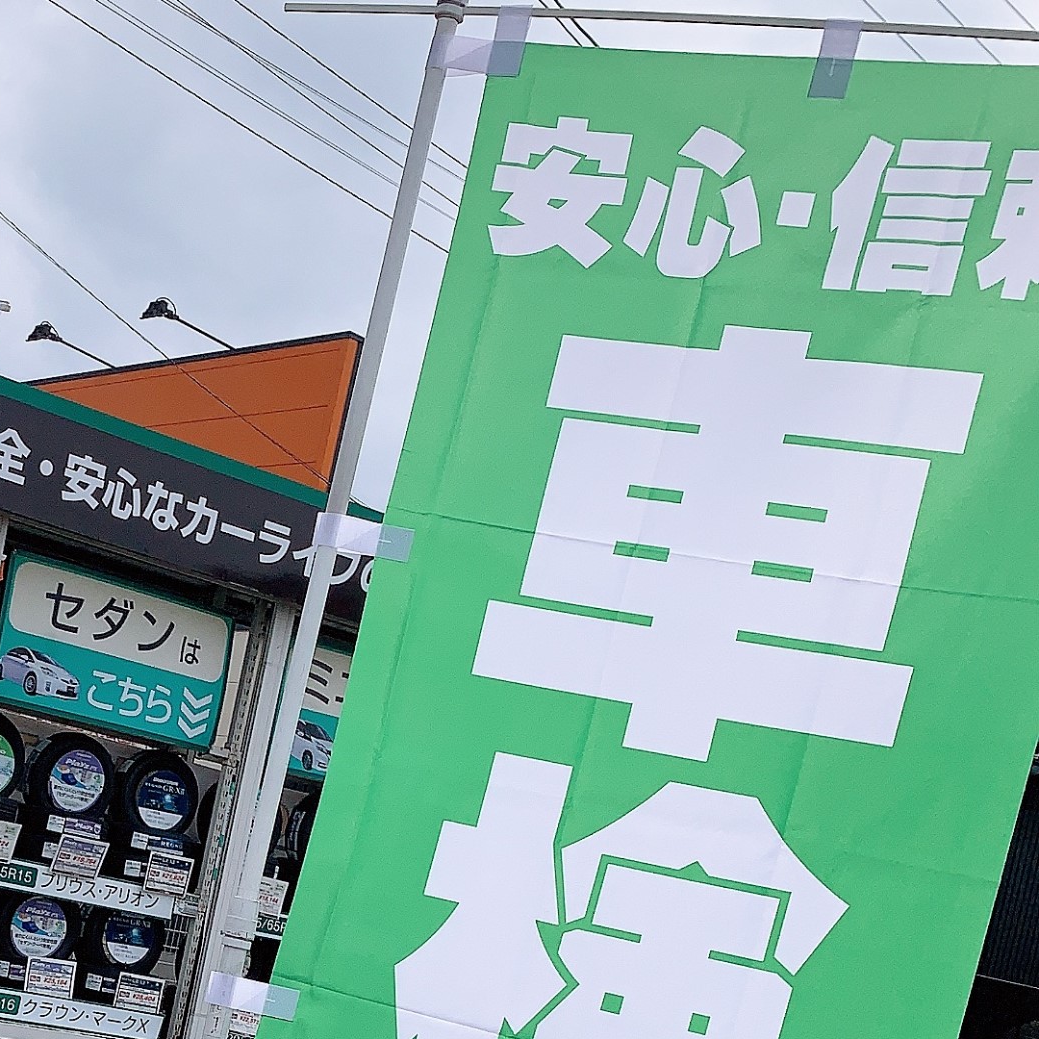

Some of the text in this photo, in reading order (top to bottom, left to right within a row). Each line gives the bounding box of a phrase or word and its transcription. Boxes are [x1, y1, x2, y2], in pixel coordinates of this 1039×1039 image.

[86, 669, 173, 724] こちら
[40, 872, 160, 908] プリウス・アリオン
[23, 999, 151, 1034] クラウン・マークX
